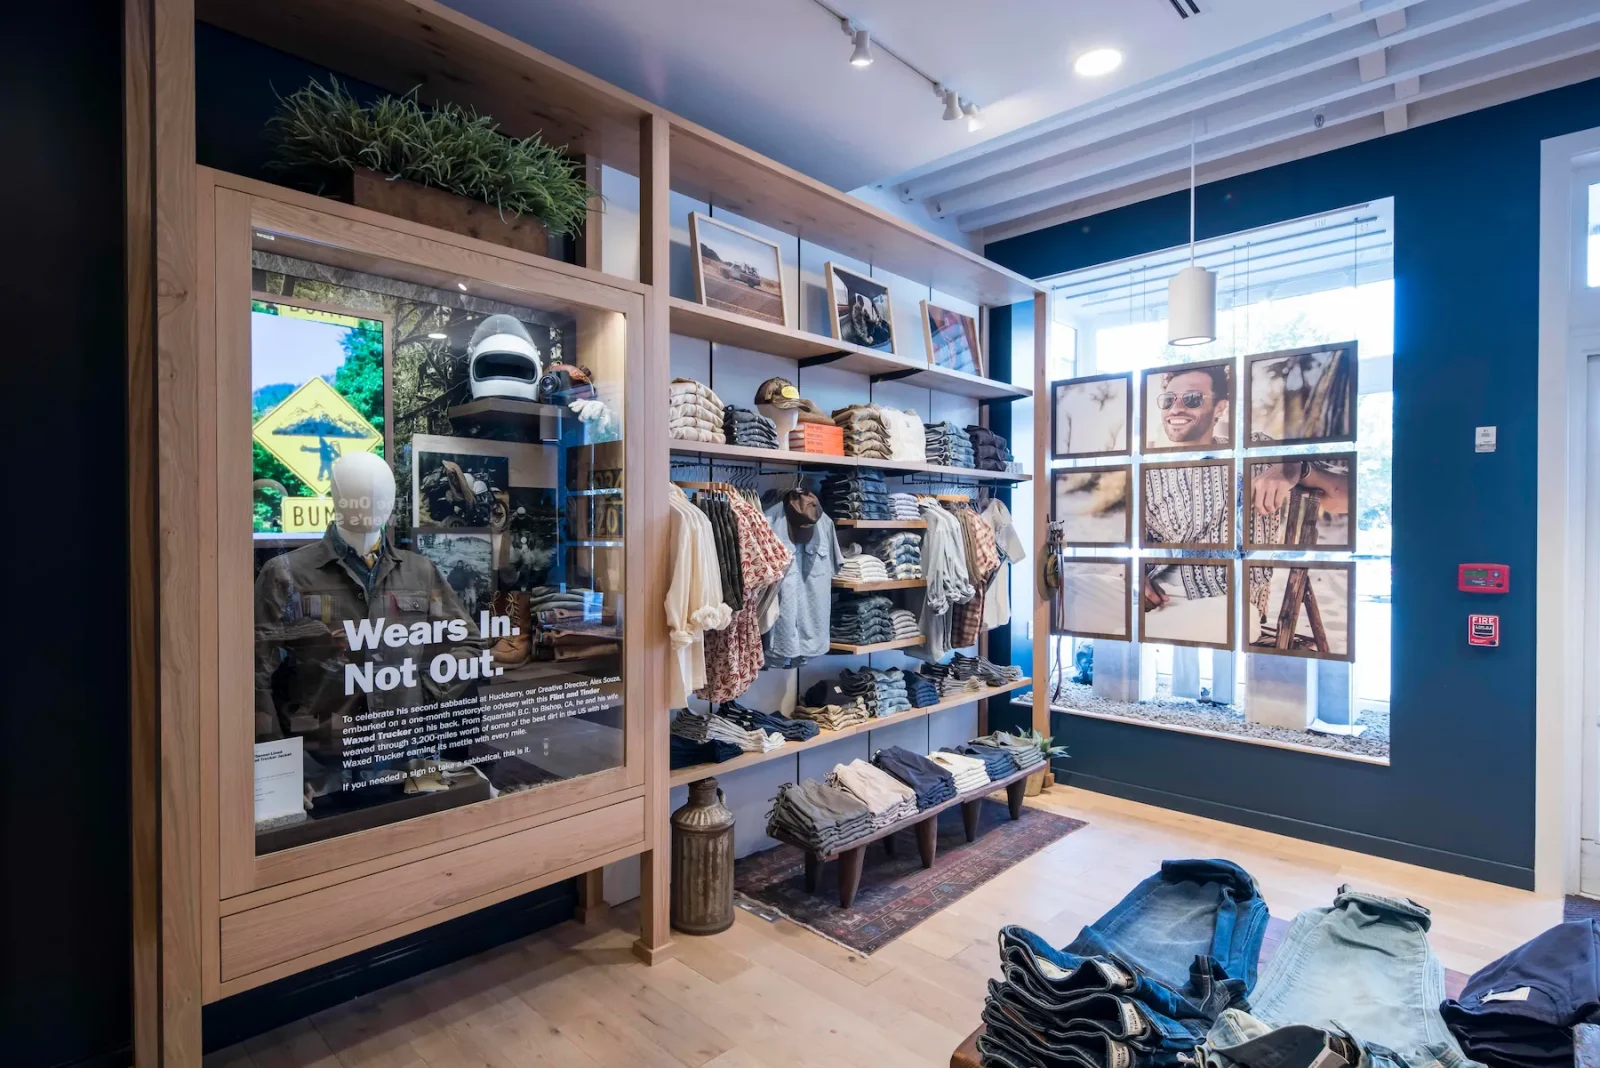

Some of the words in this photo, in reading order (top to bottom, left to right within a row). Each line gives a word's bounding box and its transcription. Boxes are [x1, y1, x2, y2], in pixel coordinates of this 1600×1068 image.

[293, 505, 335, 526] BUM
[343, 617, 469, 651] Wears
[480, 610, 520, 639] In.
[344, 657, 417, 696] Not
[429, 649, 504, 684] Out.
[342, 721, 386, 734] embarked
[409, 711, 450, 724] one-month
[452, 705, 491, 717] motorcycle
[493, 701, 519, 710] odyssey
[521, 697, 534, 706] with
[549, 692, 565, 701] Flint
[580, 687, 600, 696] Tinder
[355, 711, 394, 721] celebrate
[396, 707, 408, 715] his
[410, 702, 438, 713] second
[440, 696, 478, 708] sabbatical
[489, 690, 524, 701] Huckberry,
[538, 684, 563, 693] Creative
[564, 681, 588, 689] Director,
[589, 678, 602, 686] Alex
[342, 733, 375, 746] Waxed
[377, 729, 412, 740] Trucker
[426, 724, 438, 732] his
[440, 720, 460, 729] back.
[462, 717, 480, 726] From
[482, 710, 516, 722] Squamish
[517, 707, 530, 716] B.C.
[540, 702, 563, 712] Bishop,
[342, 745, 375, 757] weaved
[377, 739, 409, 751] through
[411, 731, 457, 745] 3,200-miles
[460, 726, 480, 736] worth
[481, 724, 489, 732] of
[490, 722, 509, 731] some
[511, 719, 518, 727] of
[520, 716, 530, 725] the
[532, 714, 546, 723] best
[566, 709, 576, 717] the
[342, 756, 372, 768] Waxed
[374, 751, 405, 762] Trucker
[406, 744, 436, 756] earning
[438, 743, 447, 751] its
[449, 738, 473, 748] mettle
[474, 734, 490, 743] with
[491, 732, 509, 741] every
[511, 728, 527, 737] mile.
[342, 783, 349, 792] If
[351, 781, 366, 791] you
[369, 773, 400, 786] needed
[409, 768, 426, 777] sign
[428, 766, 436, 774] to
[438, 762, 454, 771] take
[463, 753, 501, 766] sabbatical,
[503, 749, 516, 758] this
